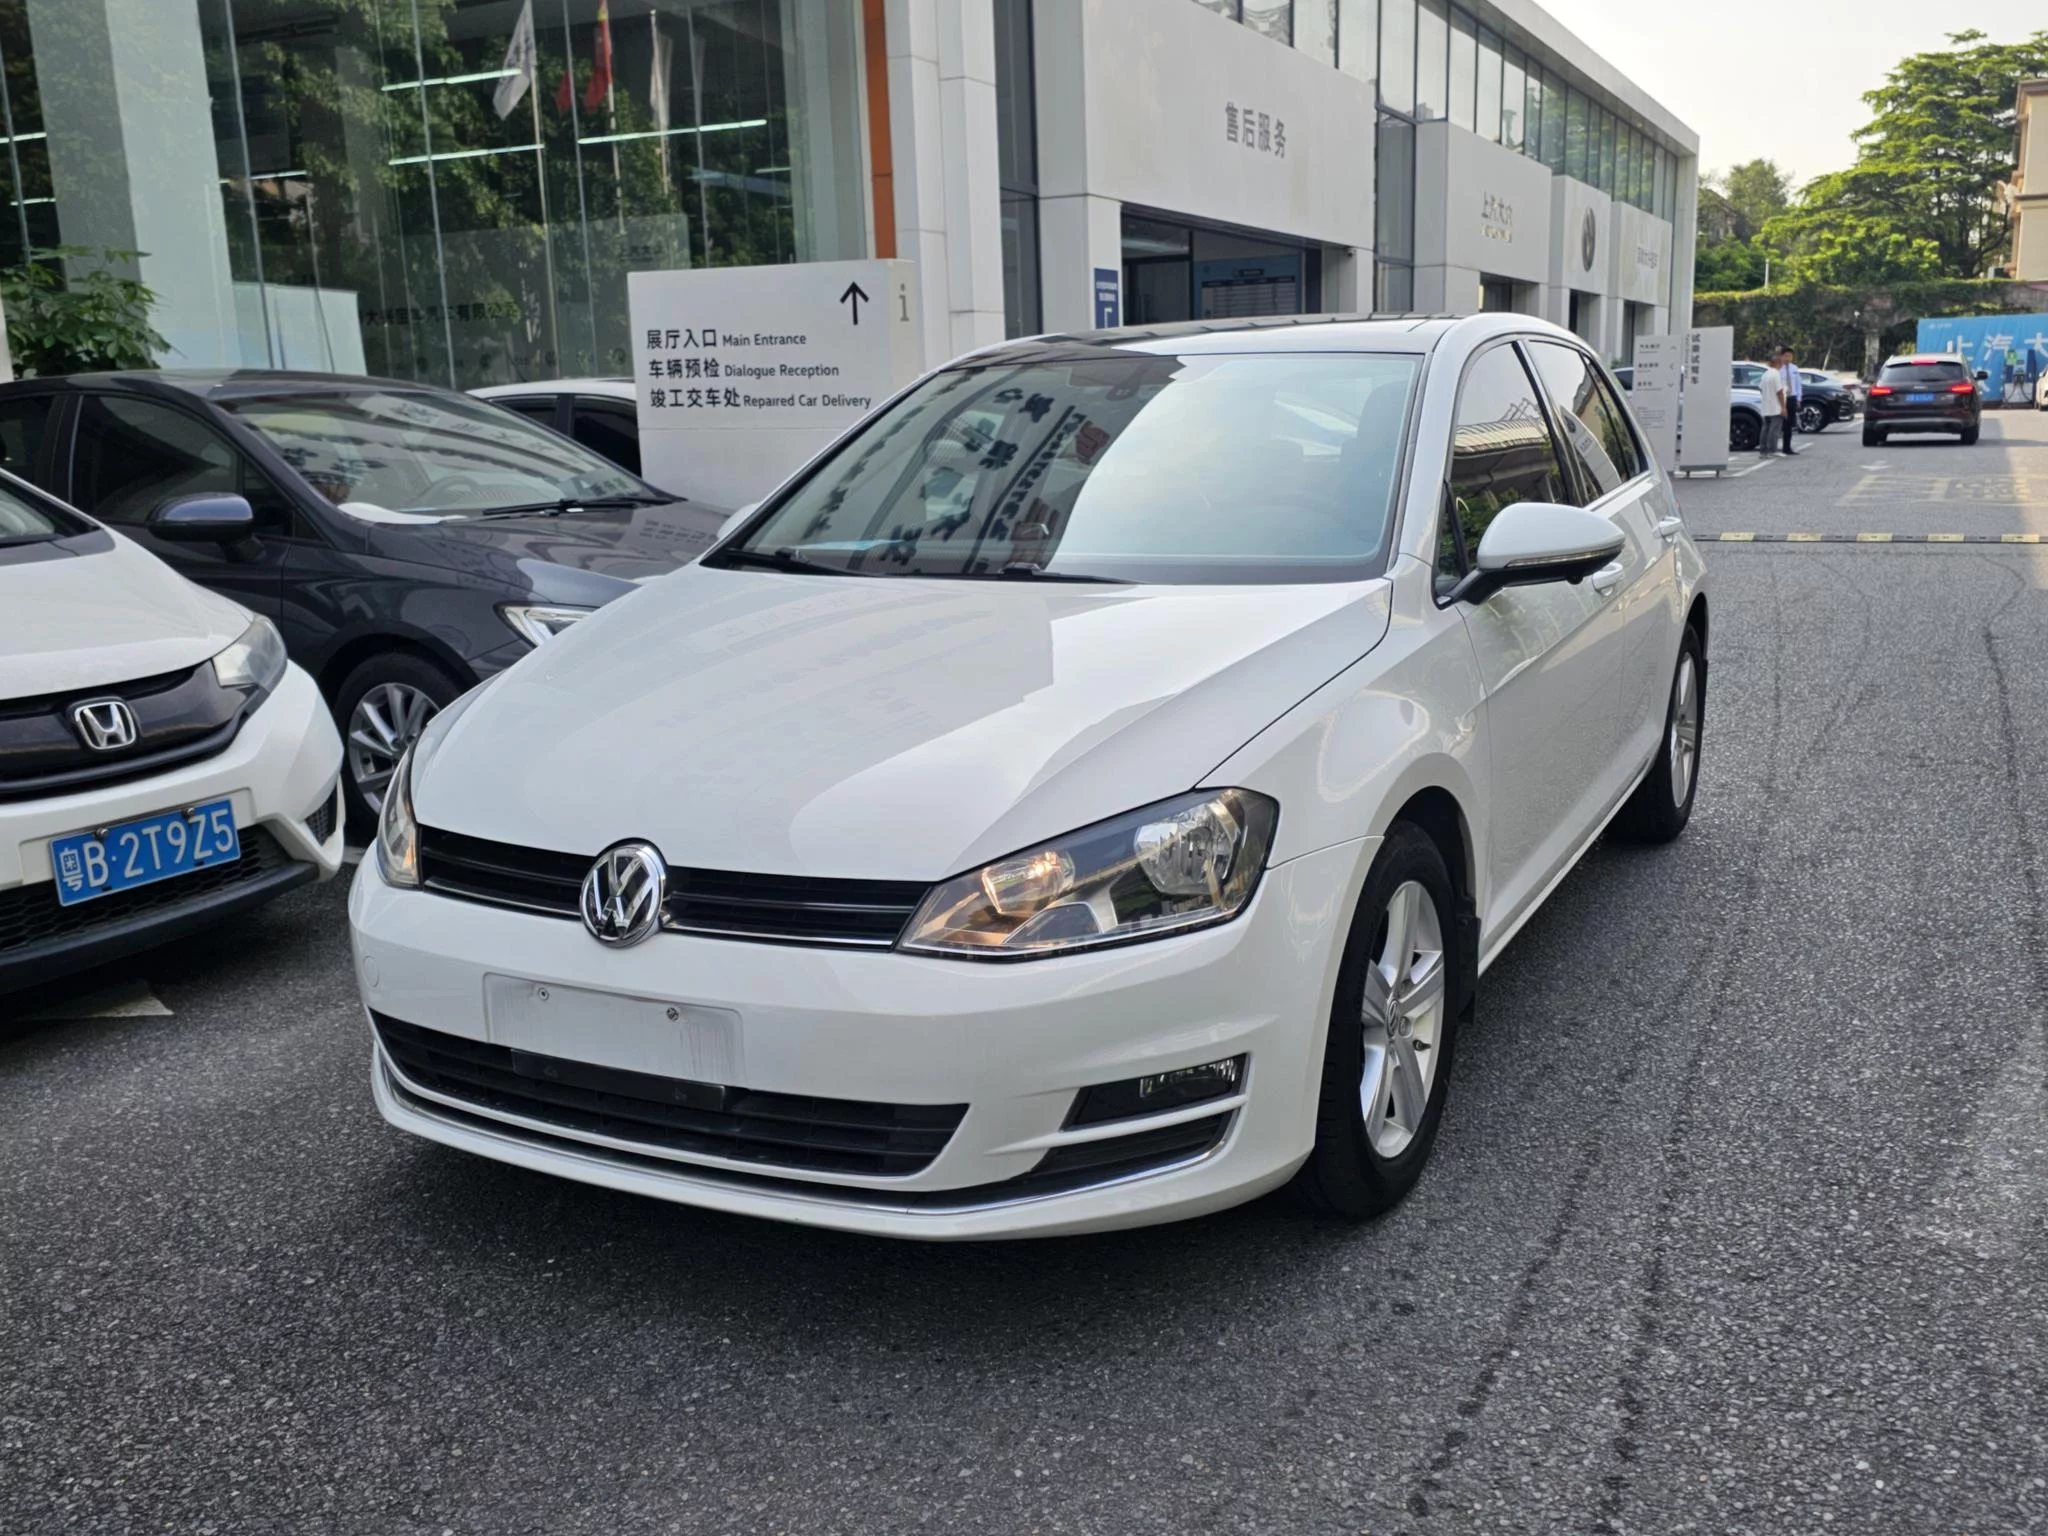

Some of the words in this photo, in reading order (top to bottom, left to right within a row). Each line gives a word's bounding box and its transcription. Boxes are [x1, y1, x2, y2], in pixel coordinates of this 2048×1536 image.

[646, 328, 717, 349] 展厅入口
[722, 334, 750, 346] Main
[754, 333, 807, 346] Entrance
[648, 358, 720, 379] 车辆预检
[724, 364, 776, 379] Dialogue
[779, 363, 839, 379] Reception
[650, 387, 741, 409] 竣工交车处
[743, 394, 795, 408] Repaired
[798, 394, 818, 407] Car
[822, 394, 871, 409] Delivery
